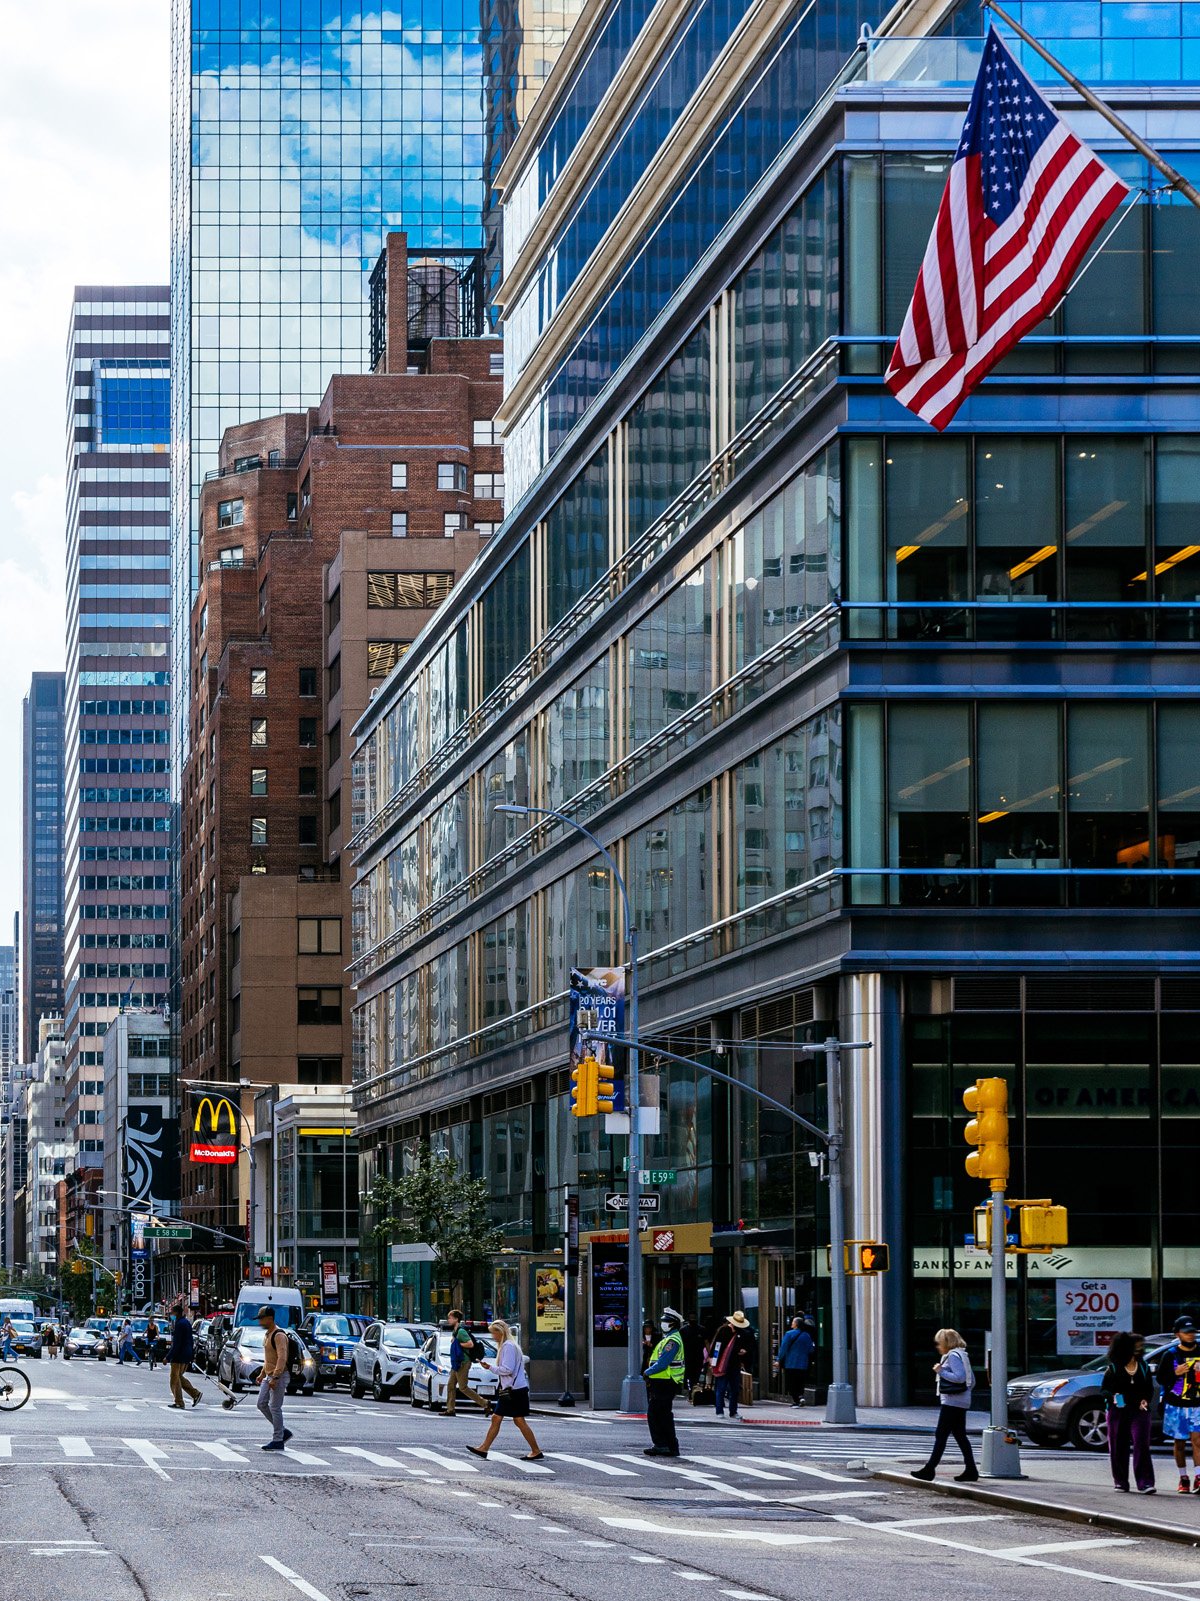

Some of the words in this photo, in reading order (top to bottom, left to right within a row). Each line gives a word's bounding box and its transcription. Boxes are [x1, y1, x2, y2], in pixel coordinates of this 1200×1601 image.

[580, 997, 589, 1005] 20
[591, 996, 616, 1005] YEARS
[1034, 1088, 1069, 1106] OF
[1075, 1088, 1200, 1106] AMERCA
[194, 1149, 235, 1157] McDonald's
[652, 1172, 657, 1183] E
[659, 1172, 668, 1183] 59
[654, 1230, 674, 1250] HOME
[913, 1261, 950, 1269] BANK
[954, 1261, 970, 1269] OF
[1081, 1281, 1099, 1290] Get
[1065, 1292, 1120, 1313] $200
